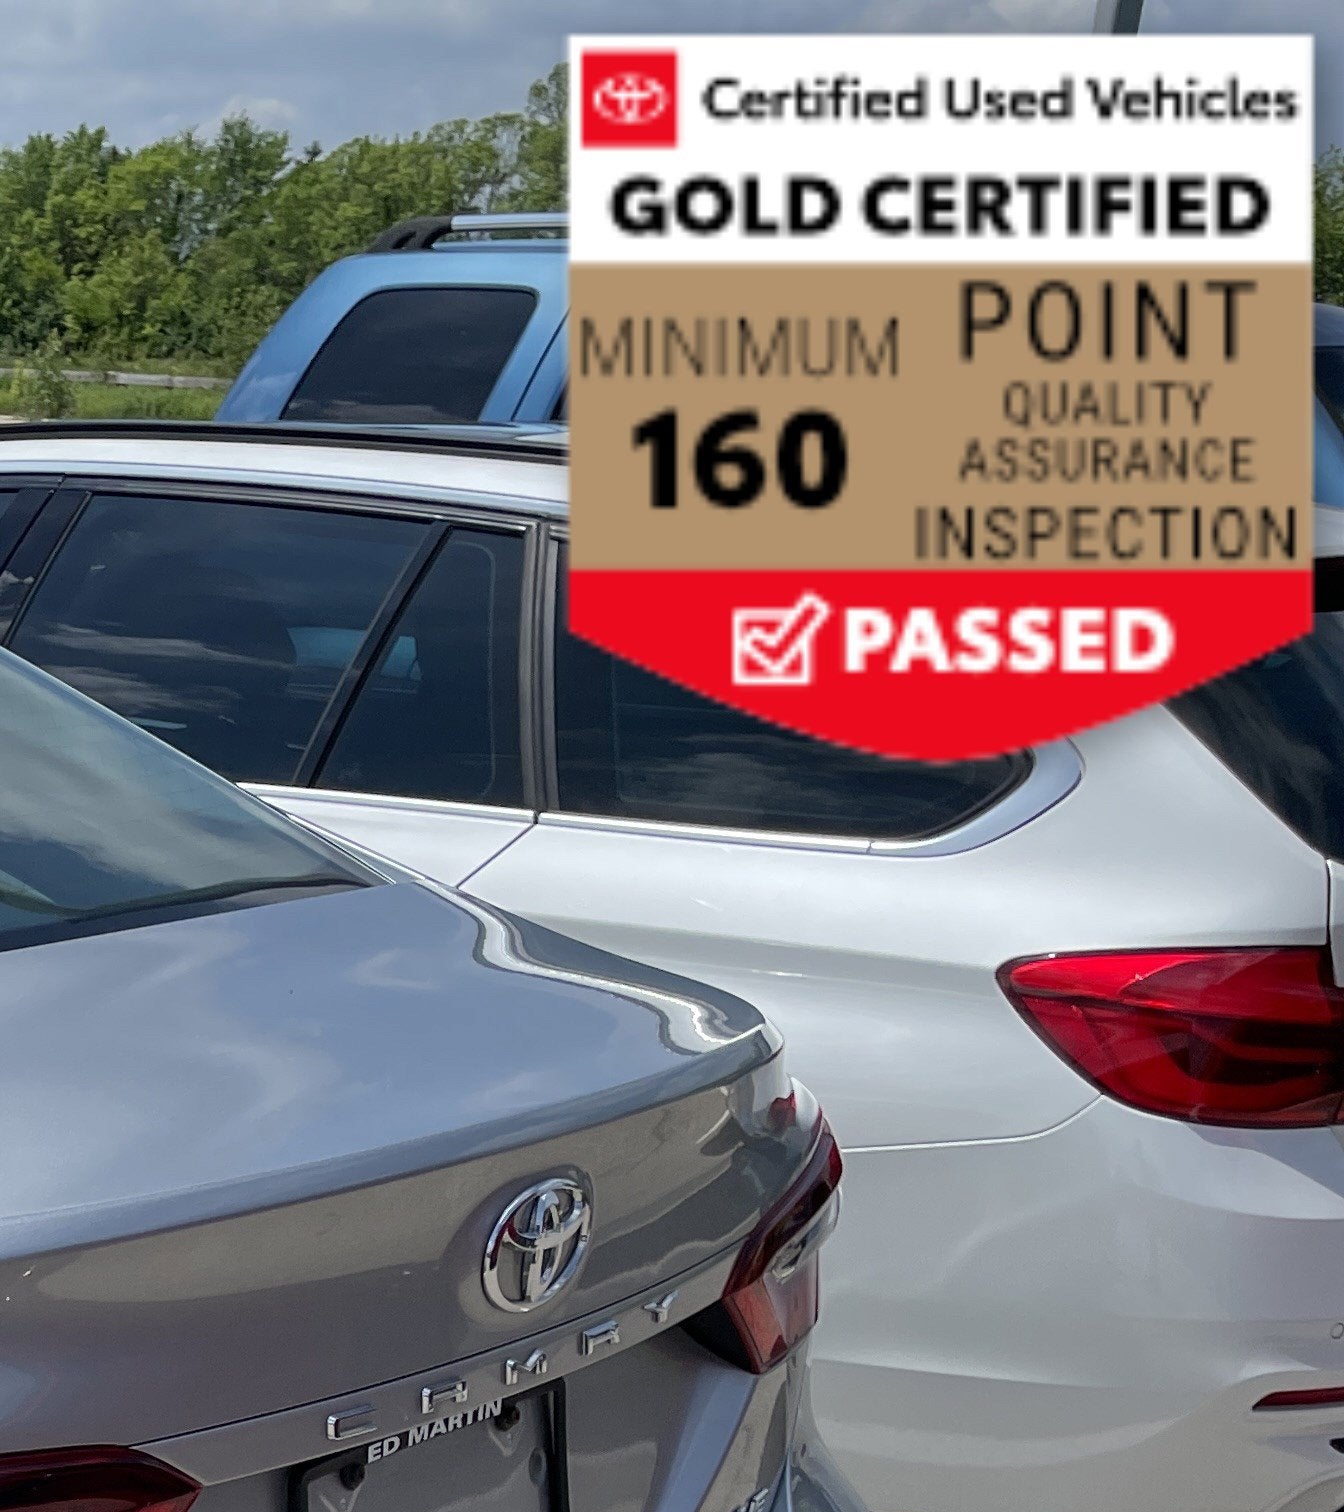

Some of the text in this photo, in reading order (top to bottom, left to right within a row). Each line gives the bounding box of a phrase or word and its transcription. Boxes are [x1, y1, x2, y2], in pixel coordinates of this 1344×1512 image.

[326, 1290, 680, 1441] CAMRY
[367, 1397, 503, 1464] ED MARTIN
